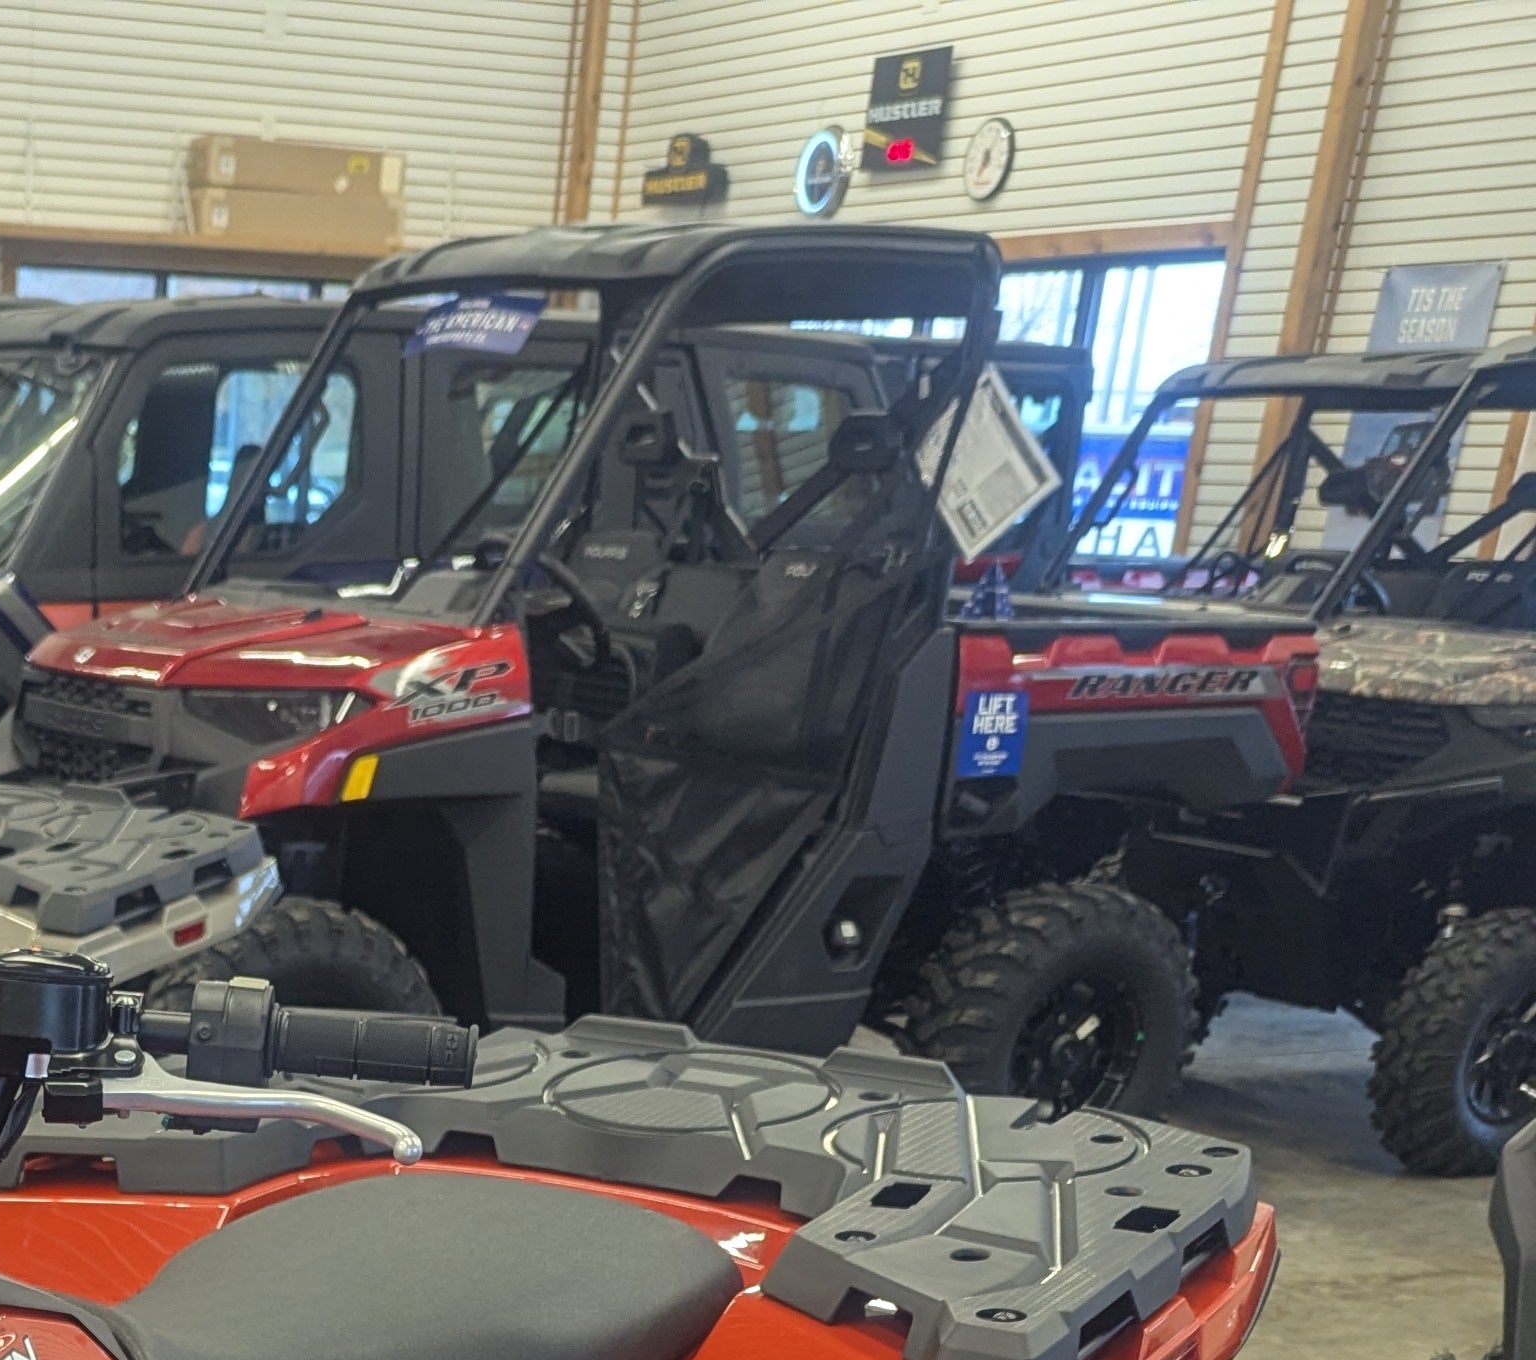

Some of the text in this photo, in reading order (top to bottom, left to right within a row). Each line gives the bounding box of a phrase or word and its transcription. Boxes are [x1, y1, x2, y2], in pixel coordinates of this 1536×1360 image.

[868, 99, 943, 123] HUSTLER
[1436, 286, 1467, 311] THE
[444, 309, 521, 334] AMERICAN
[1397, 317, 1458, 345] SEASON
[388, 660, 514, 708] XP
[1070, 669, 1259, 699] RANGER
[411, 693, 498, 721] 1000
[979, 692, 1017, 716] LIFT
[972, 713, 1018, 735] HERE
